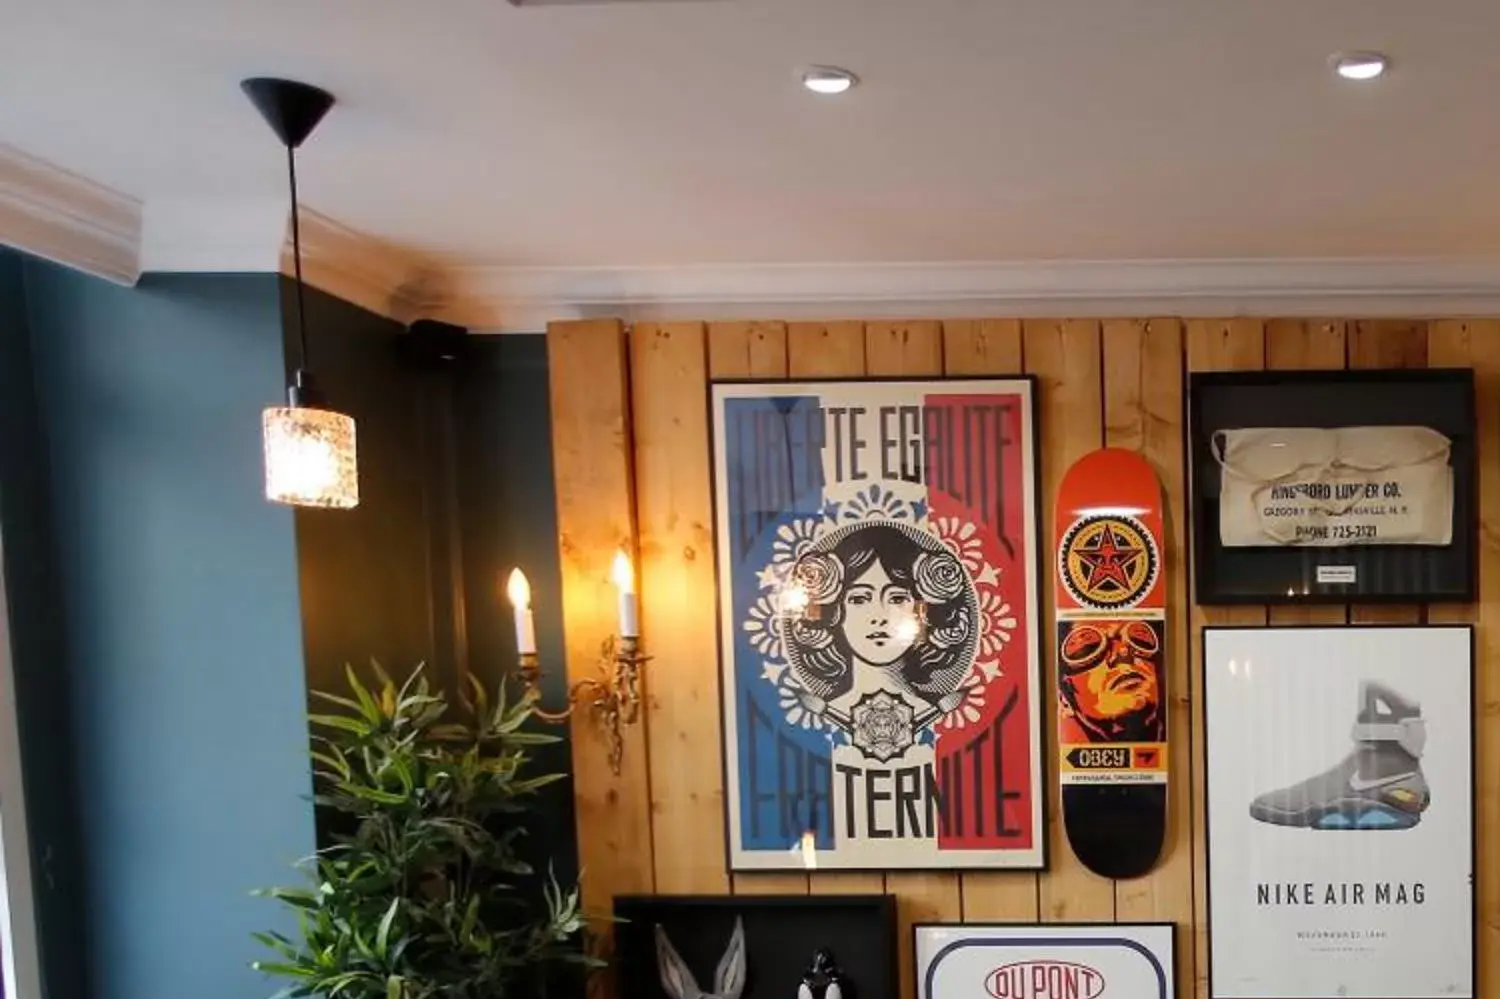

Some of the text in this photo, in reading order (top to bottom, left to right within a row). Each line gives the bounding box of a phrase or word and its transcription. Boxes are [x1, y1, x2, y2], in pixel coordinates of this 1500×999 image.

[880, 405, 1015, 561] EGALITE
[1295, 525, 1329, 539] PHONE
[748, 684, 1022, 839] FRATERNITE
[1079, 749, 1126, 767] OBEY
[1257, 883, 1426, 905] NIKE AIR MAG
